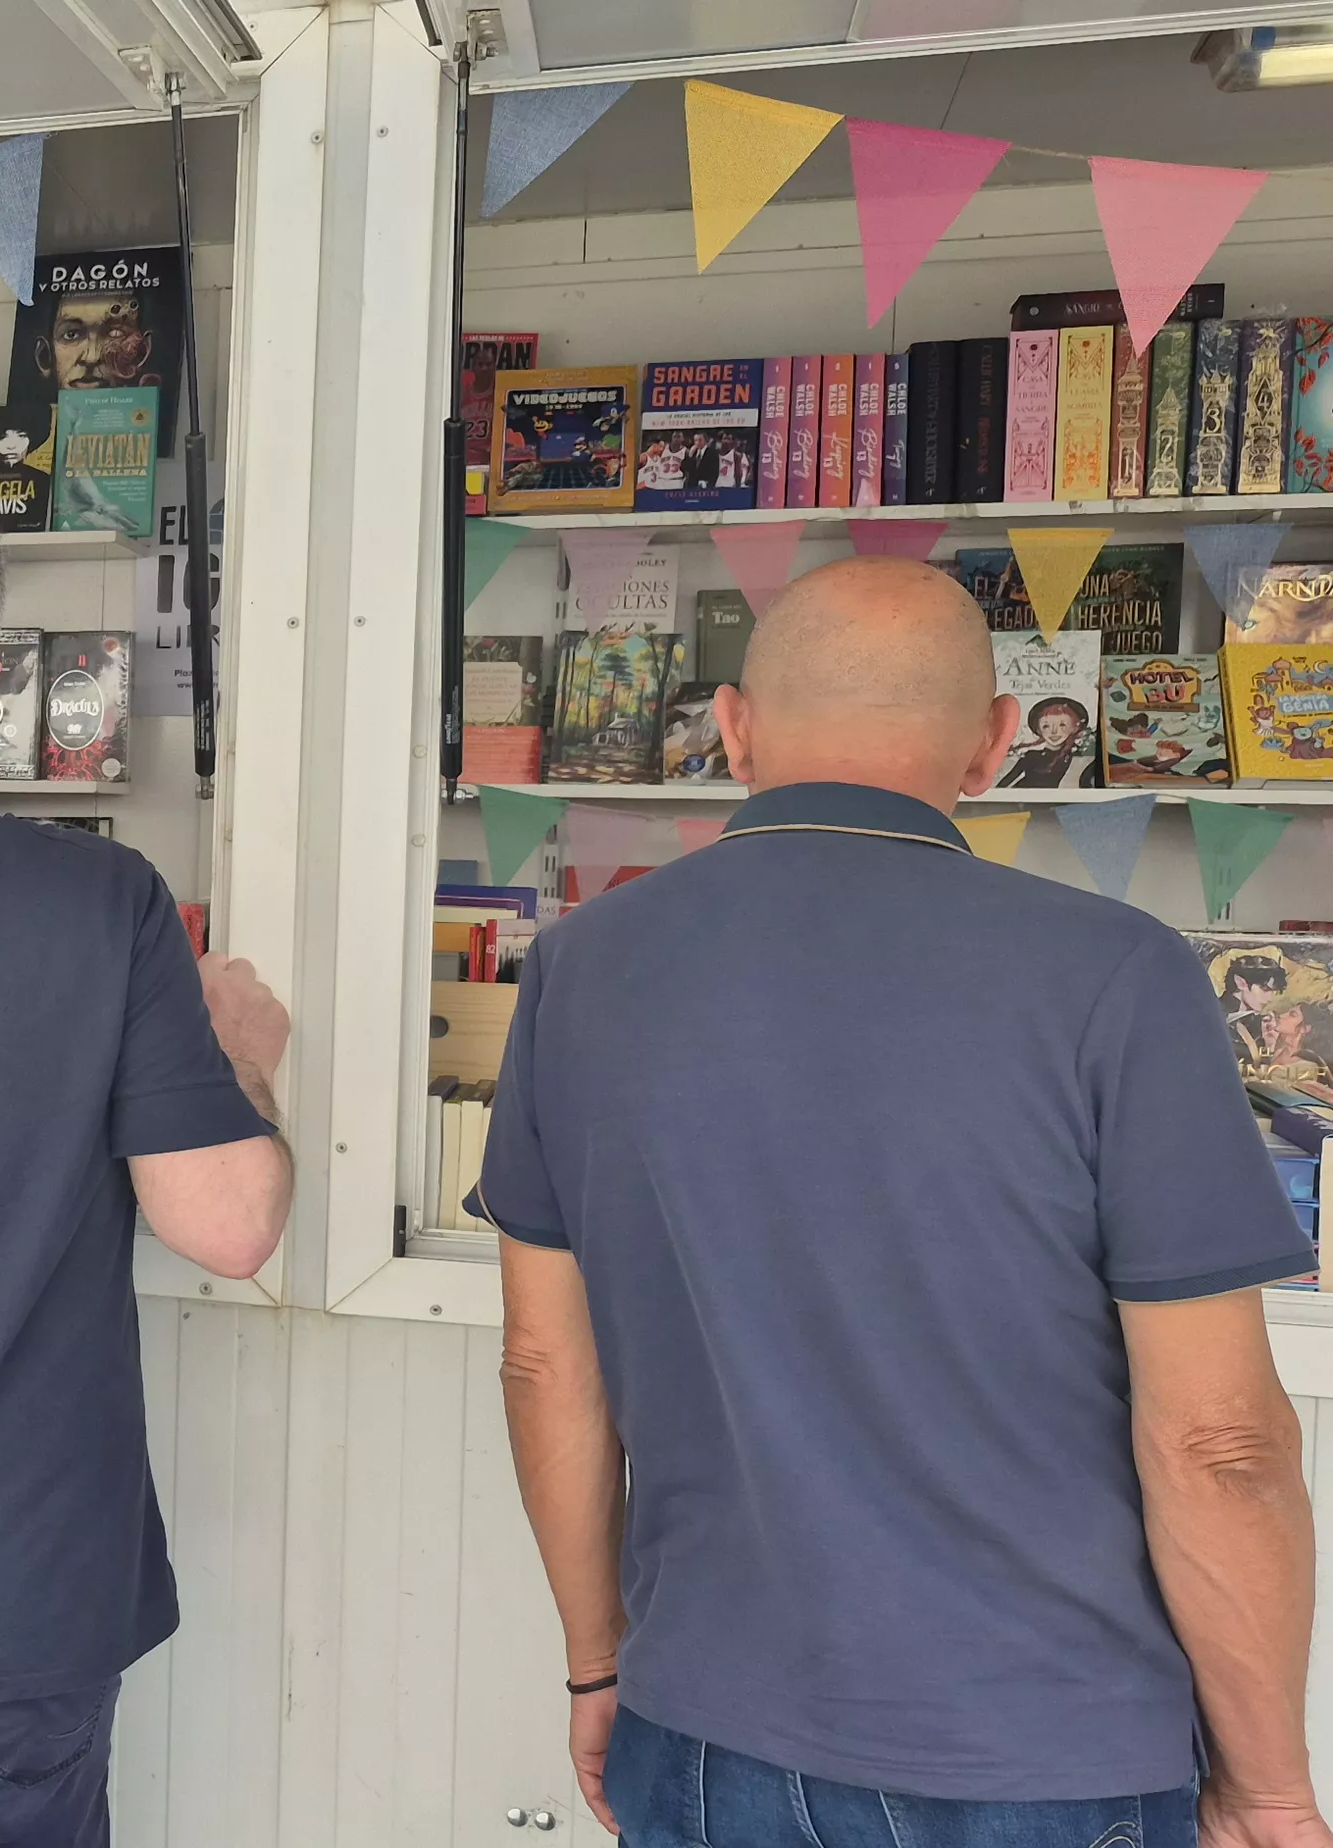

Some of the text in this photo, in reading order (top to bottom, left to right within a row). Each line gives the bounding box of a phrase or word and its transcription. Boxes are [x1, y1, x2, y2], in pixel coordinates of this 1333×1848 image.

[39, 277, 160, 292] Y OTROS RELATOS
[52, 259, 148, 282] DAGÓN
[766, 386, 776, 419] WALSH
[775, 385, 786, 418] CHLOE
[795, 384, 805, 417] WALSH
[805, 384, 815, 416] CHLOE
[828, 384, 838, 417] WALSH
[837, 383, 847, 416] CHLOE
[859, 384, 869, 416] WALSH
[869, 383, 879, 415] CHLOE
[887, 383, 897, 416] WALSH
[897, 383, 907, 415] CHLOE
[65, 429, 151, 469] LEVIATÁN
[711, 611, 740, 624] Tao
[1078, 600, 1162, 630] HERENCIA
[1112, 630, 1162, 655] JUEGO
[1130, 671, 1194, 685] HOTEL
